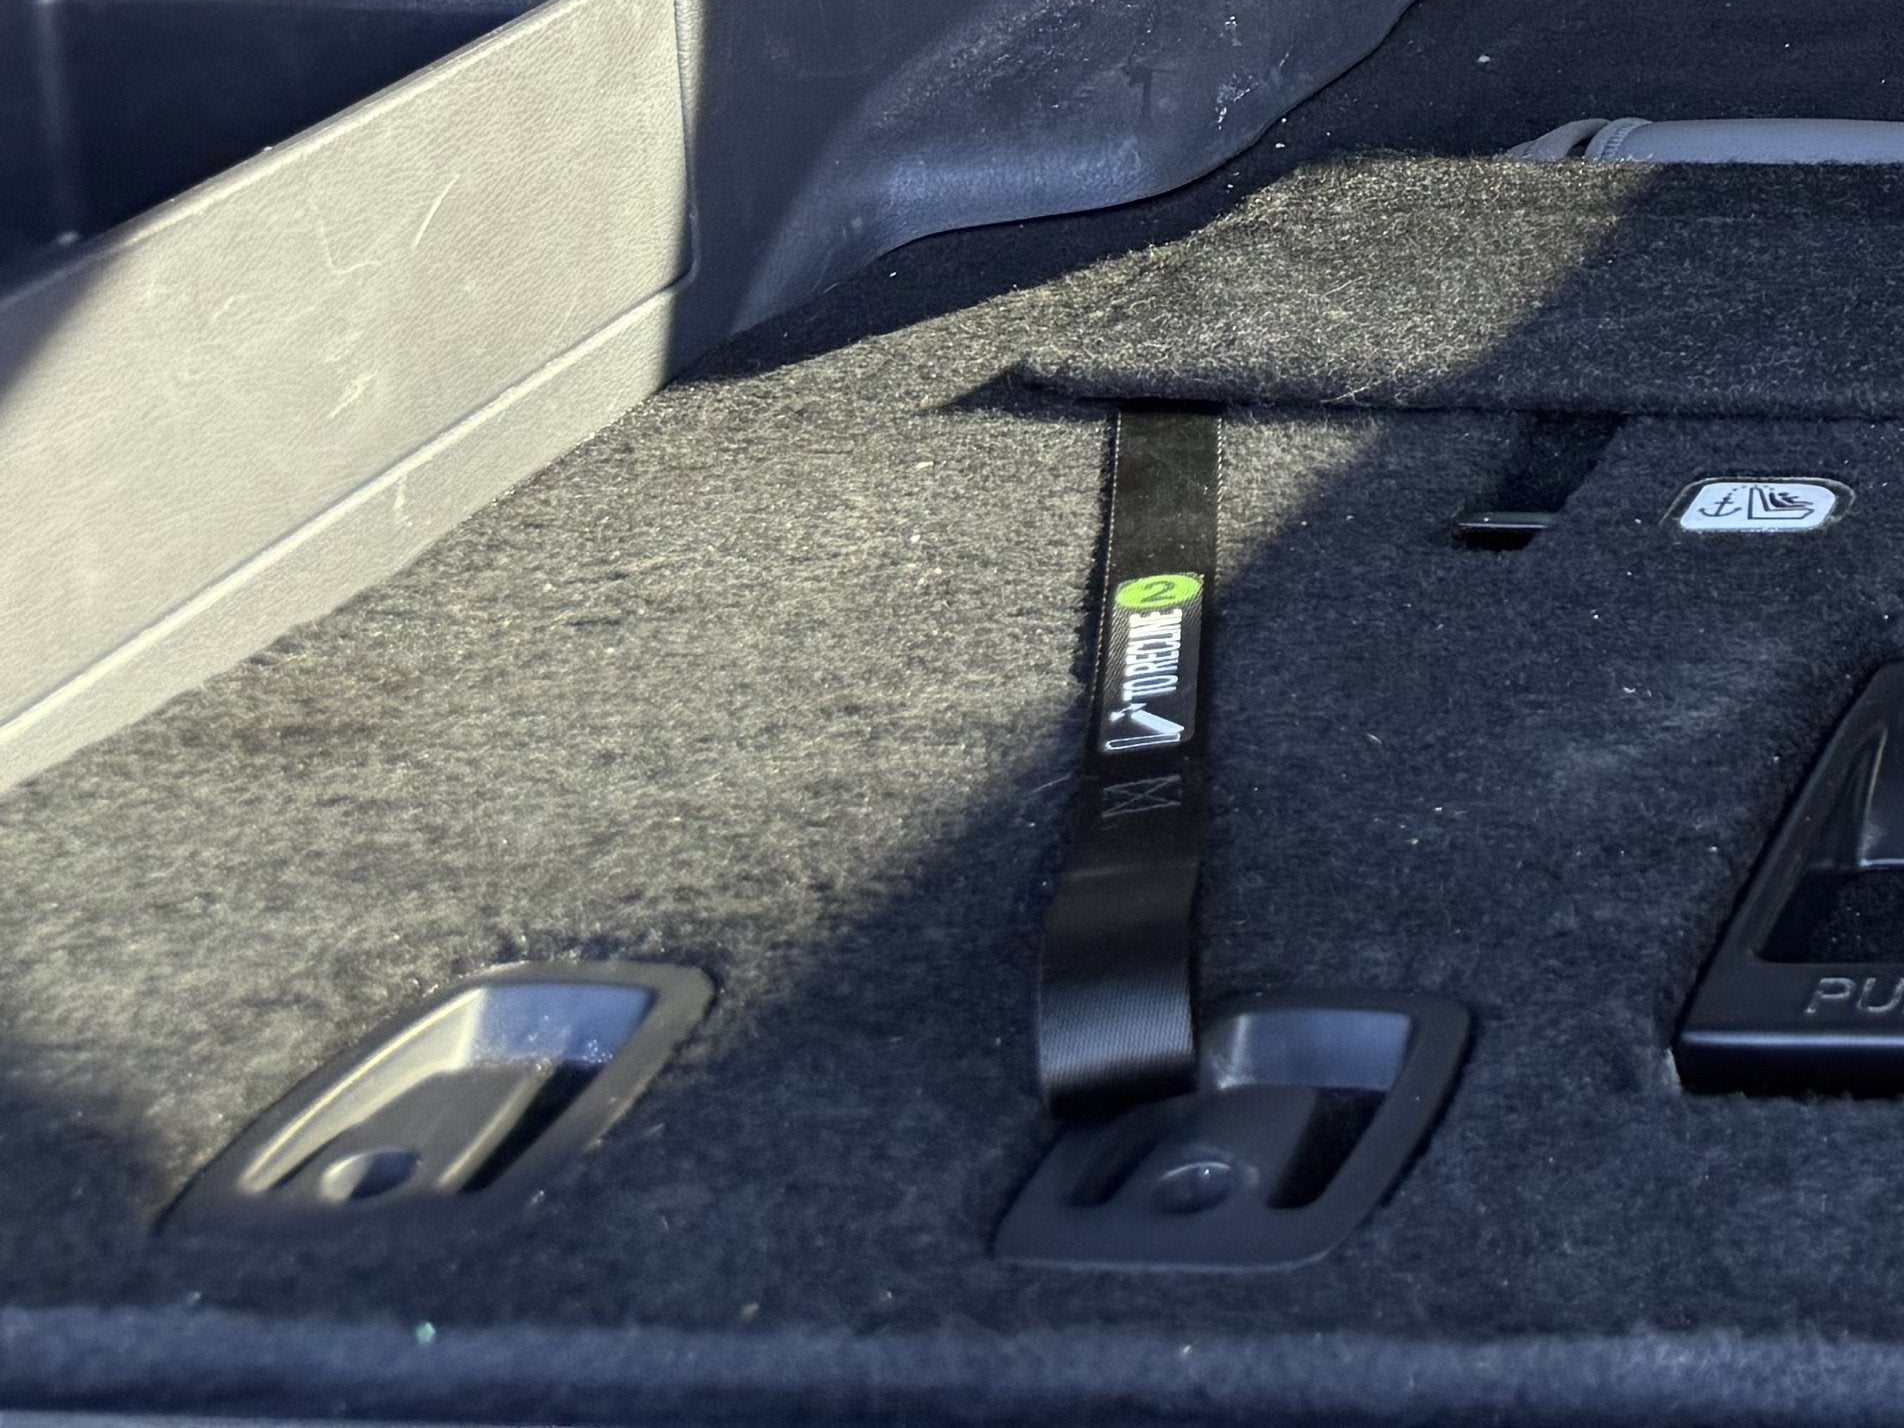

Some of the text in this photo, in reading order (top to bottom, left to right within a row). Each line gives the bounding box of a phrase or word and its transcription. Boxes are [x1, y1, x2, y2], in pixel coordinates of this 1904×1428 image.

[1140, 580, 1176, 603] 2
[1122, 608, 1183, 701] TO RECLINE
